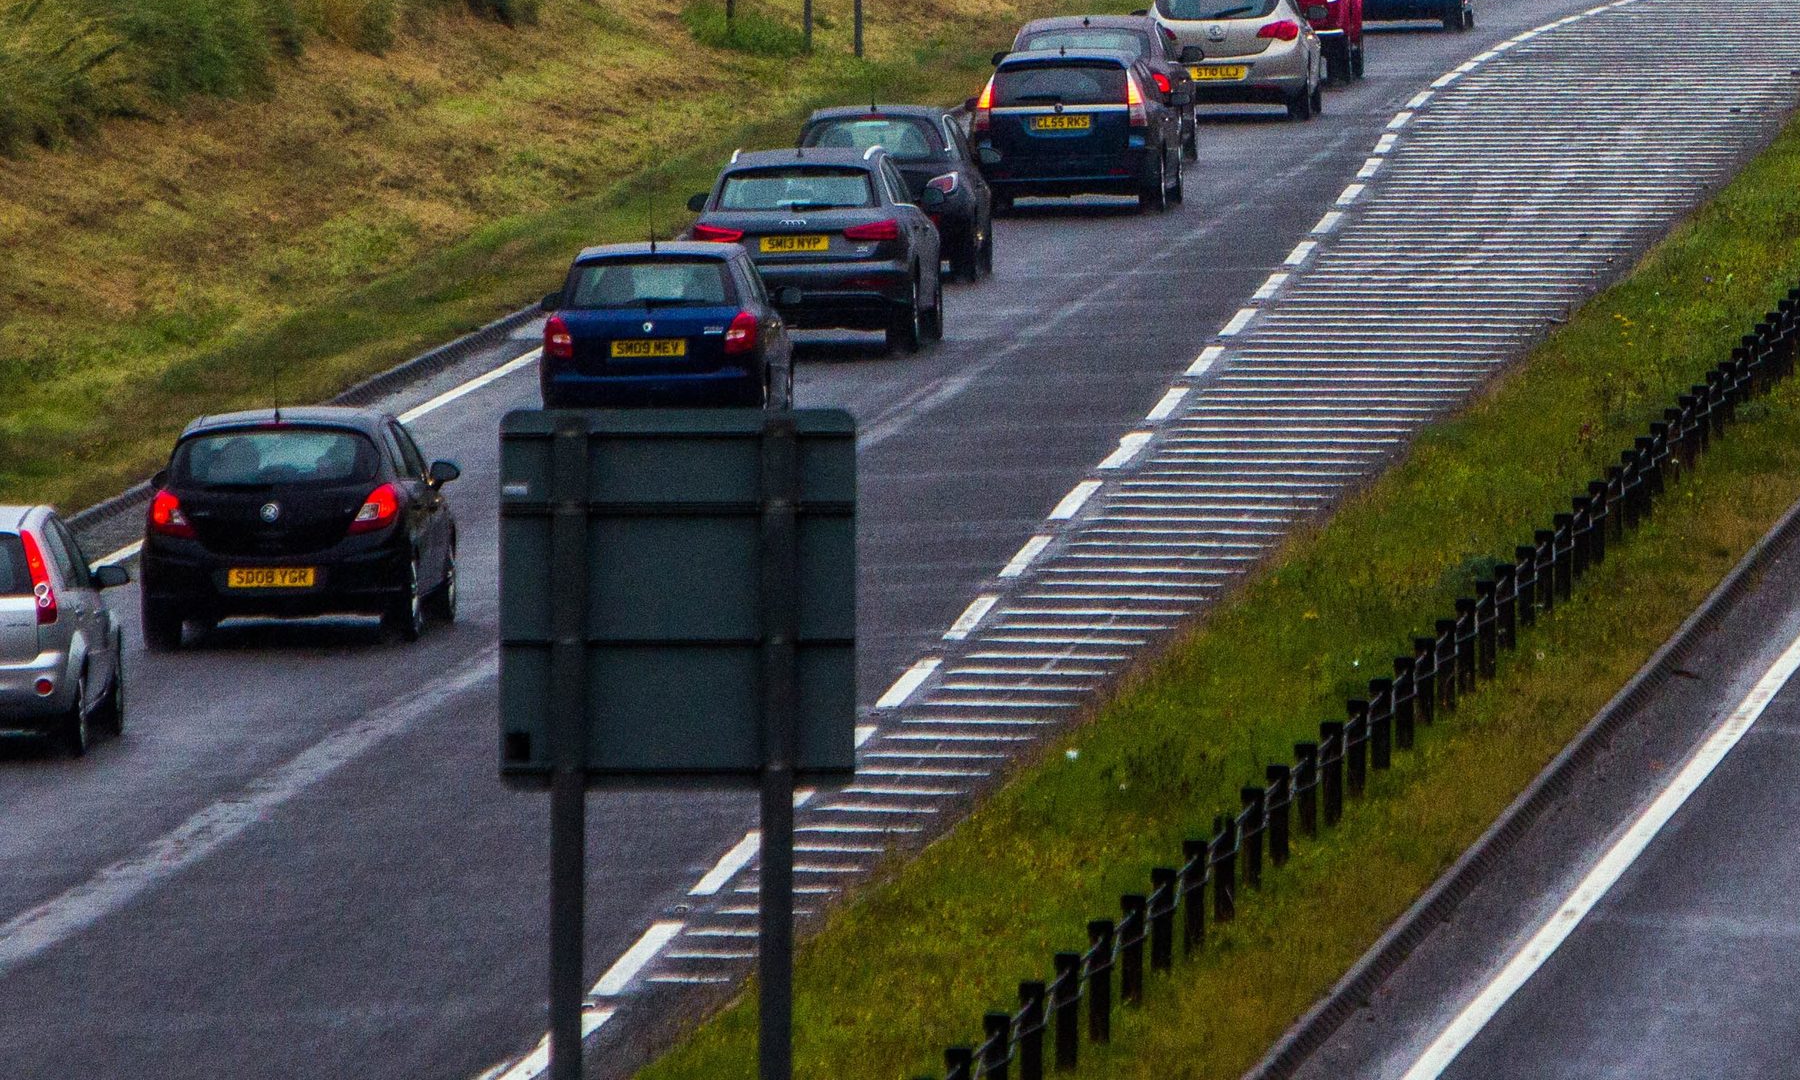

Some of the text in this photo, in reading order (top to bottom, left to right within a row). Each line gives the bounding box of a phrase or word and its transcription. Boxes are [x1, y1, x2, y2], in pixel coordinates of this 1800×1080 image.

[1037, 116, 1088, 128] CL55 RKS
[797, 236, 821, 248] NYP
[616, 341, 679, 354] SM09 MEV
[236, 570, 307, 584] SD08 YGR
